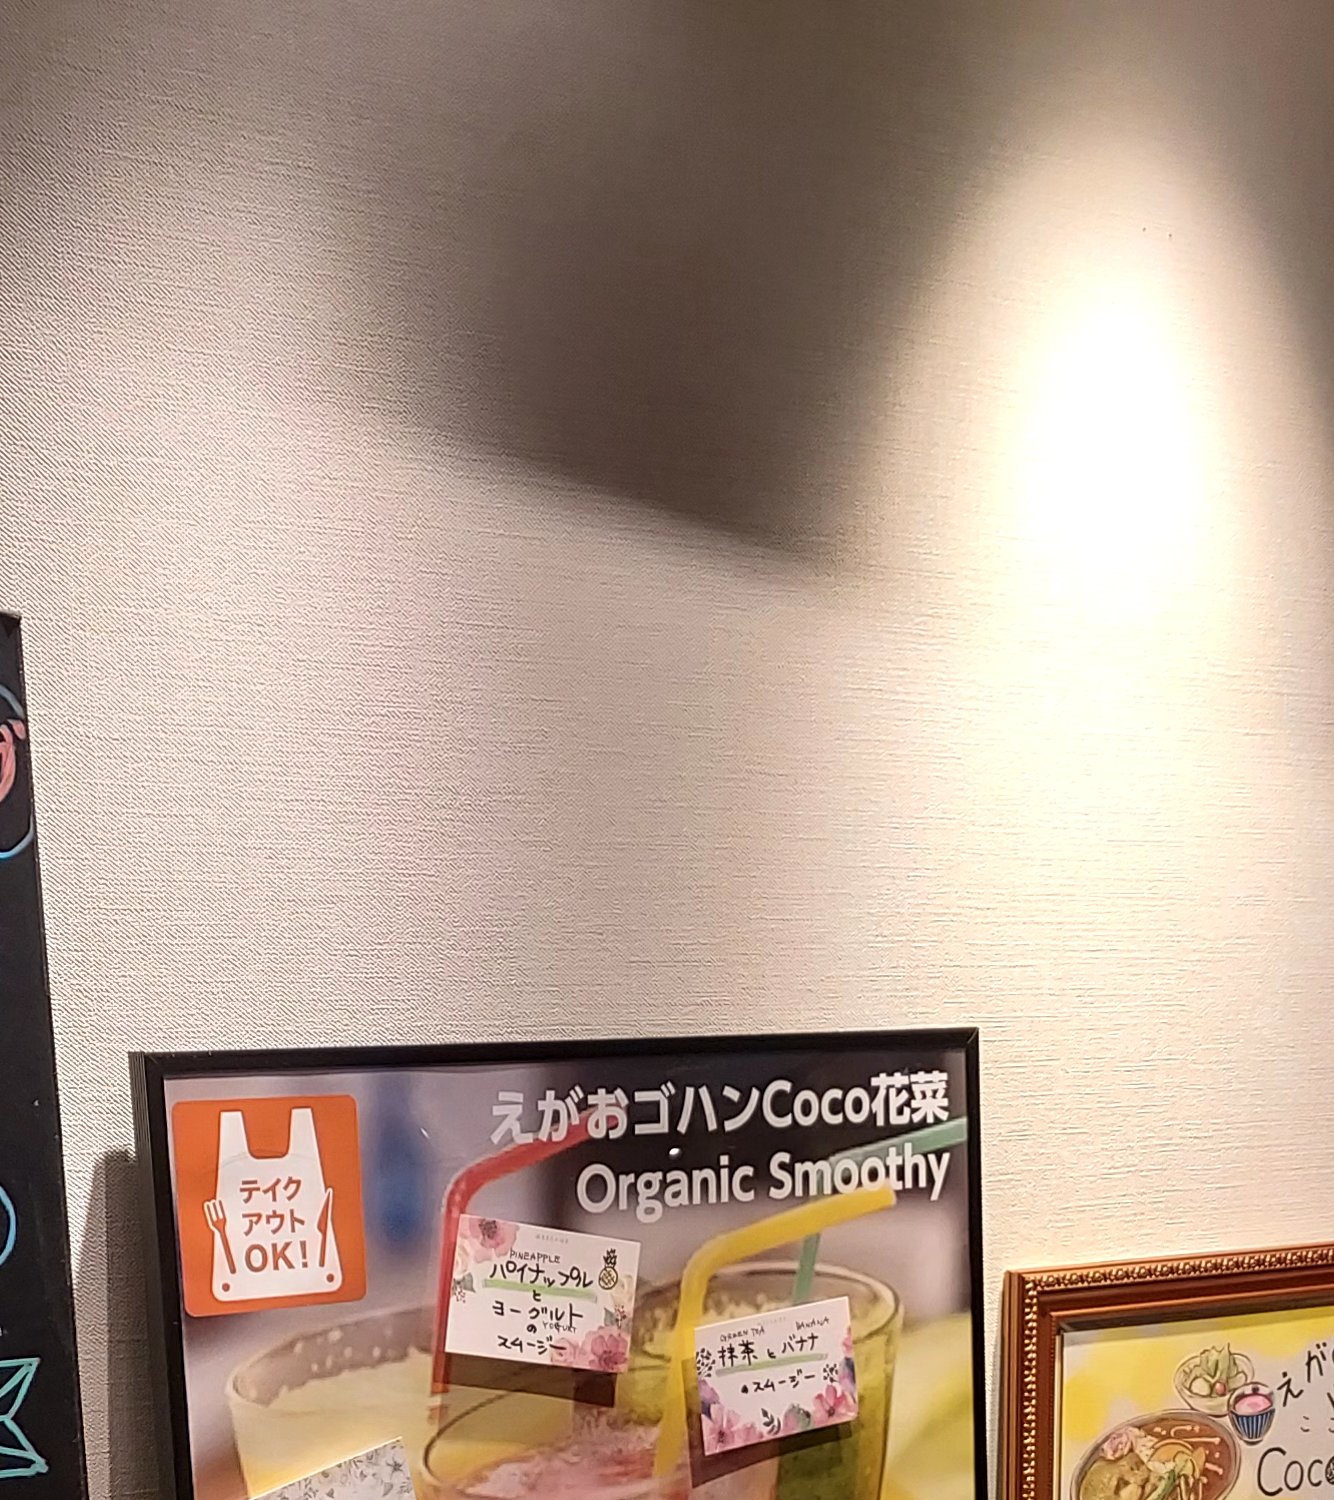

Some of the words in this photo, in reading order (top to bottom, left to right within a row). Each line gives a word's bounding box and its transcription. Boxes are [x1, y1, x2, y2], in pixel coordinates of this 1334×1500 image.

[490, 1069, 951, 1146] えがおゴハンCoco花菜
[238, 1175, 303, 1203] テイク
[576, 1156, 756, 1224] Organic
[768, 1143, 952, 1203] Smoothy
[240, 1209, 306, 1237] アウト
[244, 1239, 310, 1273] OK!
[509, 1249, 561, 1264] PINEAPPLE
[489, 1259, 594, 1288] パイナップル
[532, 1289, 542, 1301] と
[491, 1299, 584, 1328] ヨーグルト
[496, 1334, 567, 1355] スムージー
